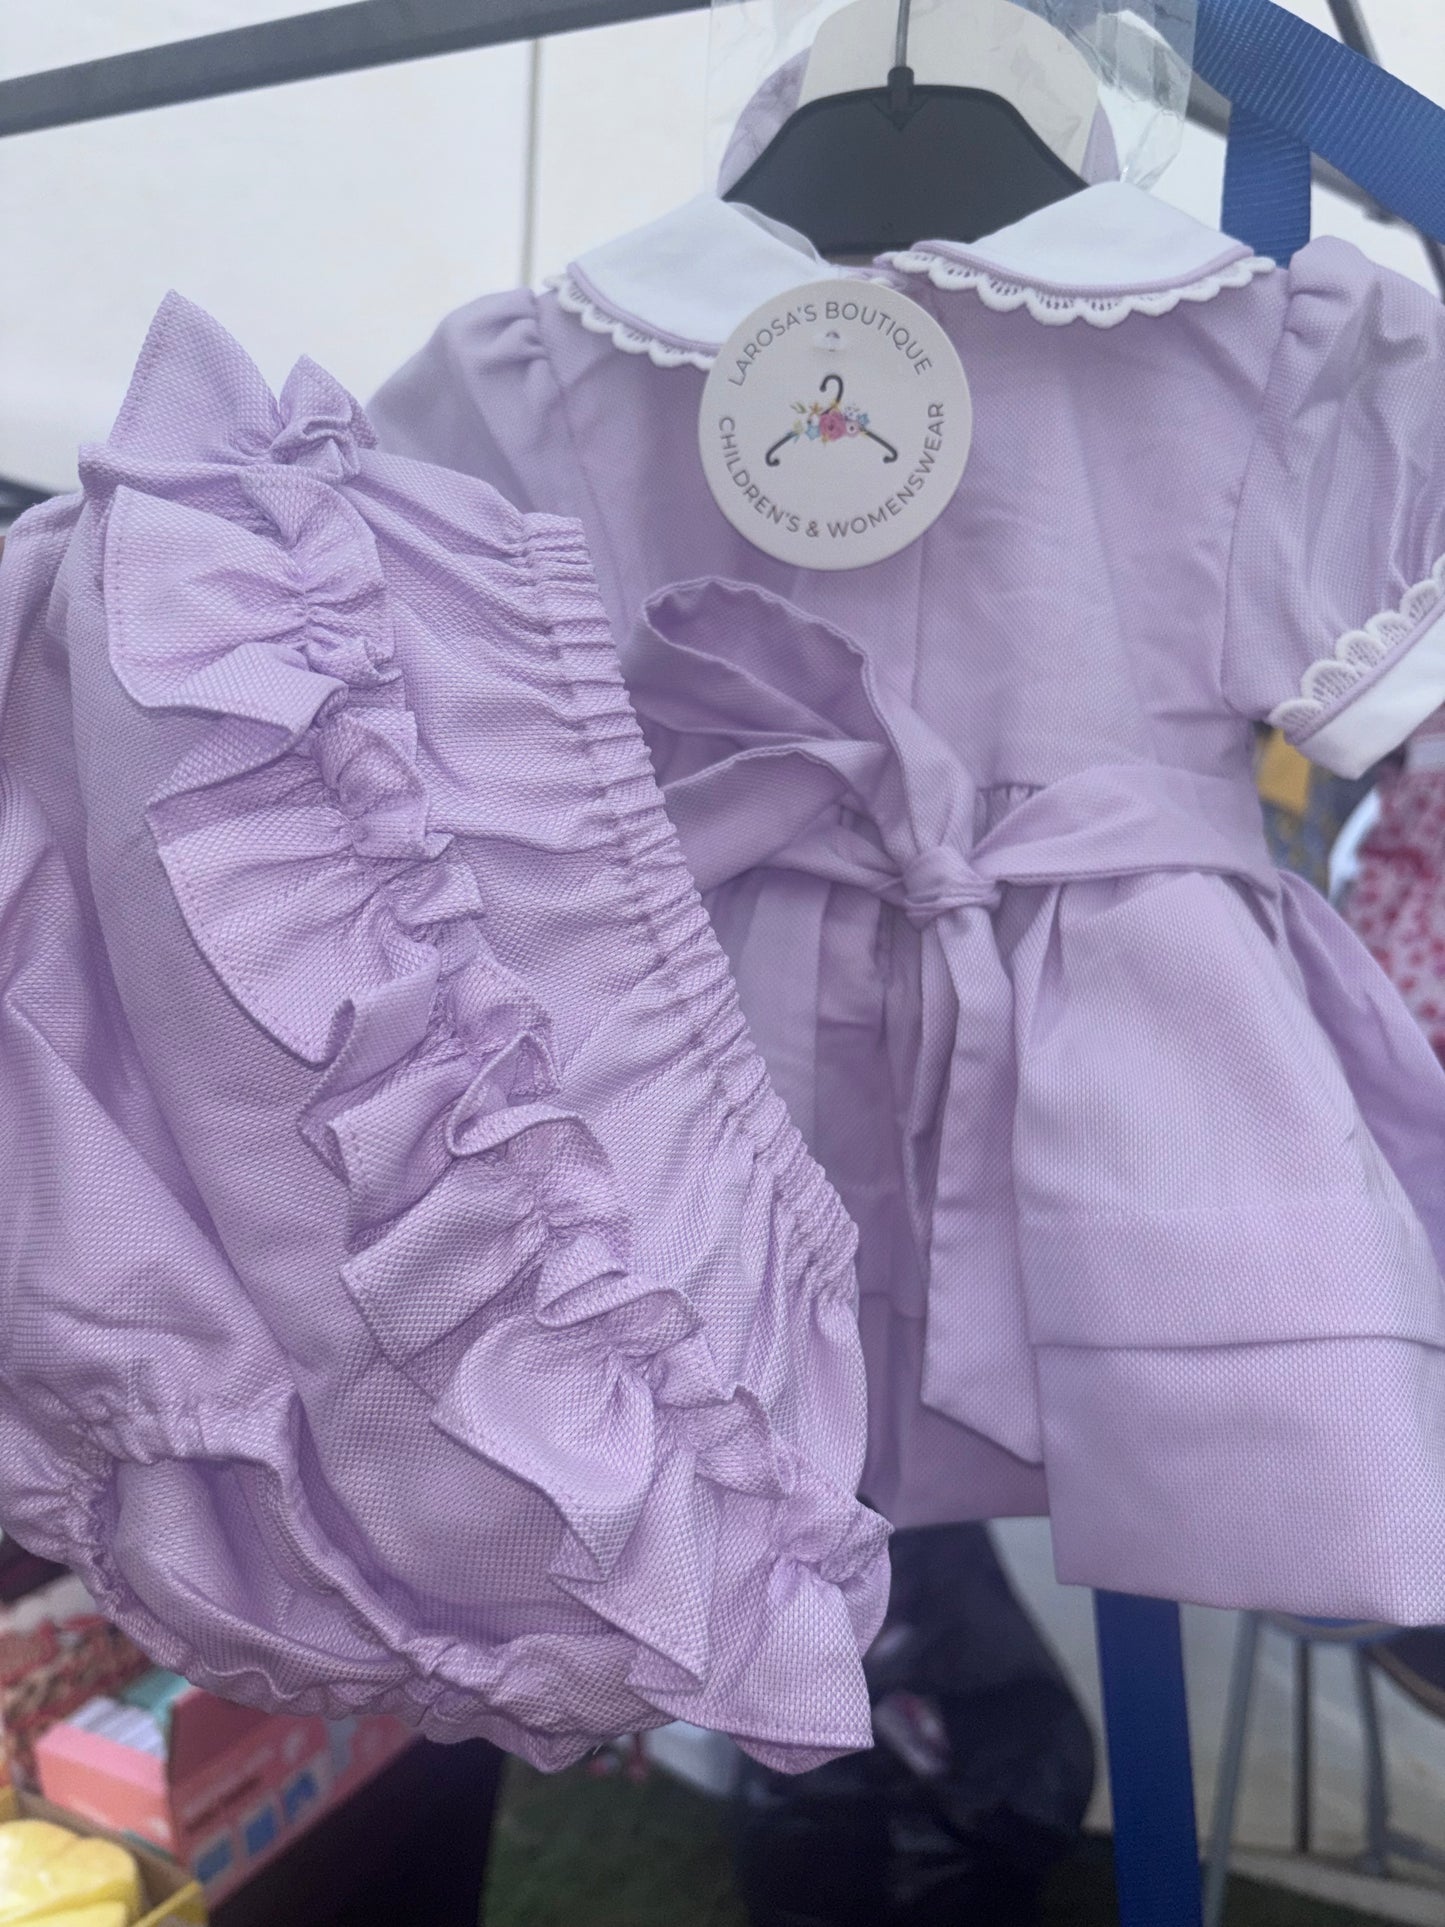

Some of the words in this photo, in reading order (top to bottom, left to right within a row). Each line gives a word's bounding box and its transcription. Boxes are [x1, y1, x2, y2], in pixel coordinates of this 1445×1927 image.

[728, 304, 818, 387] LAROSA'S
[825, 301, 933, 376] BOUTIQUE
[718, 416, 801, 533] CHILDREN'S
[805, 521, 820, 538] &
[827, 402, 944, 539] WOMENSWEAR
